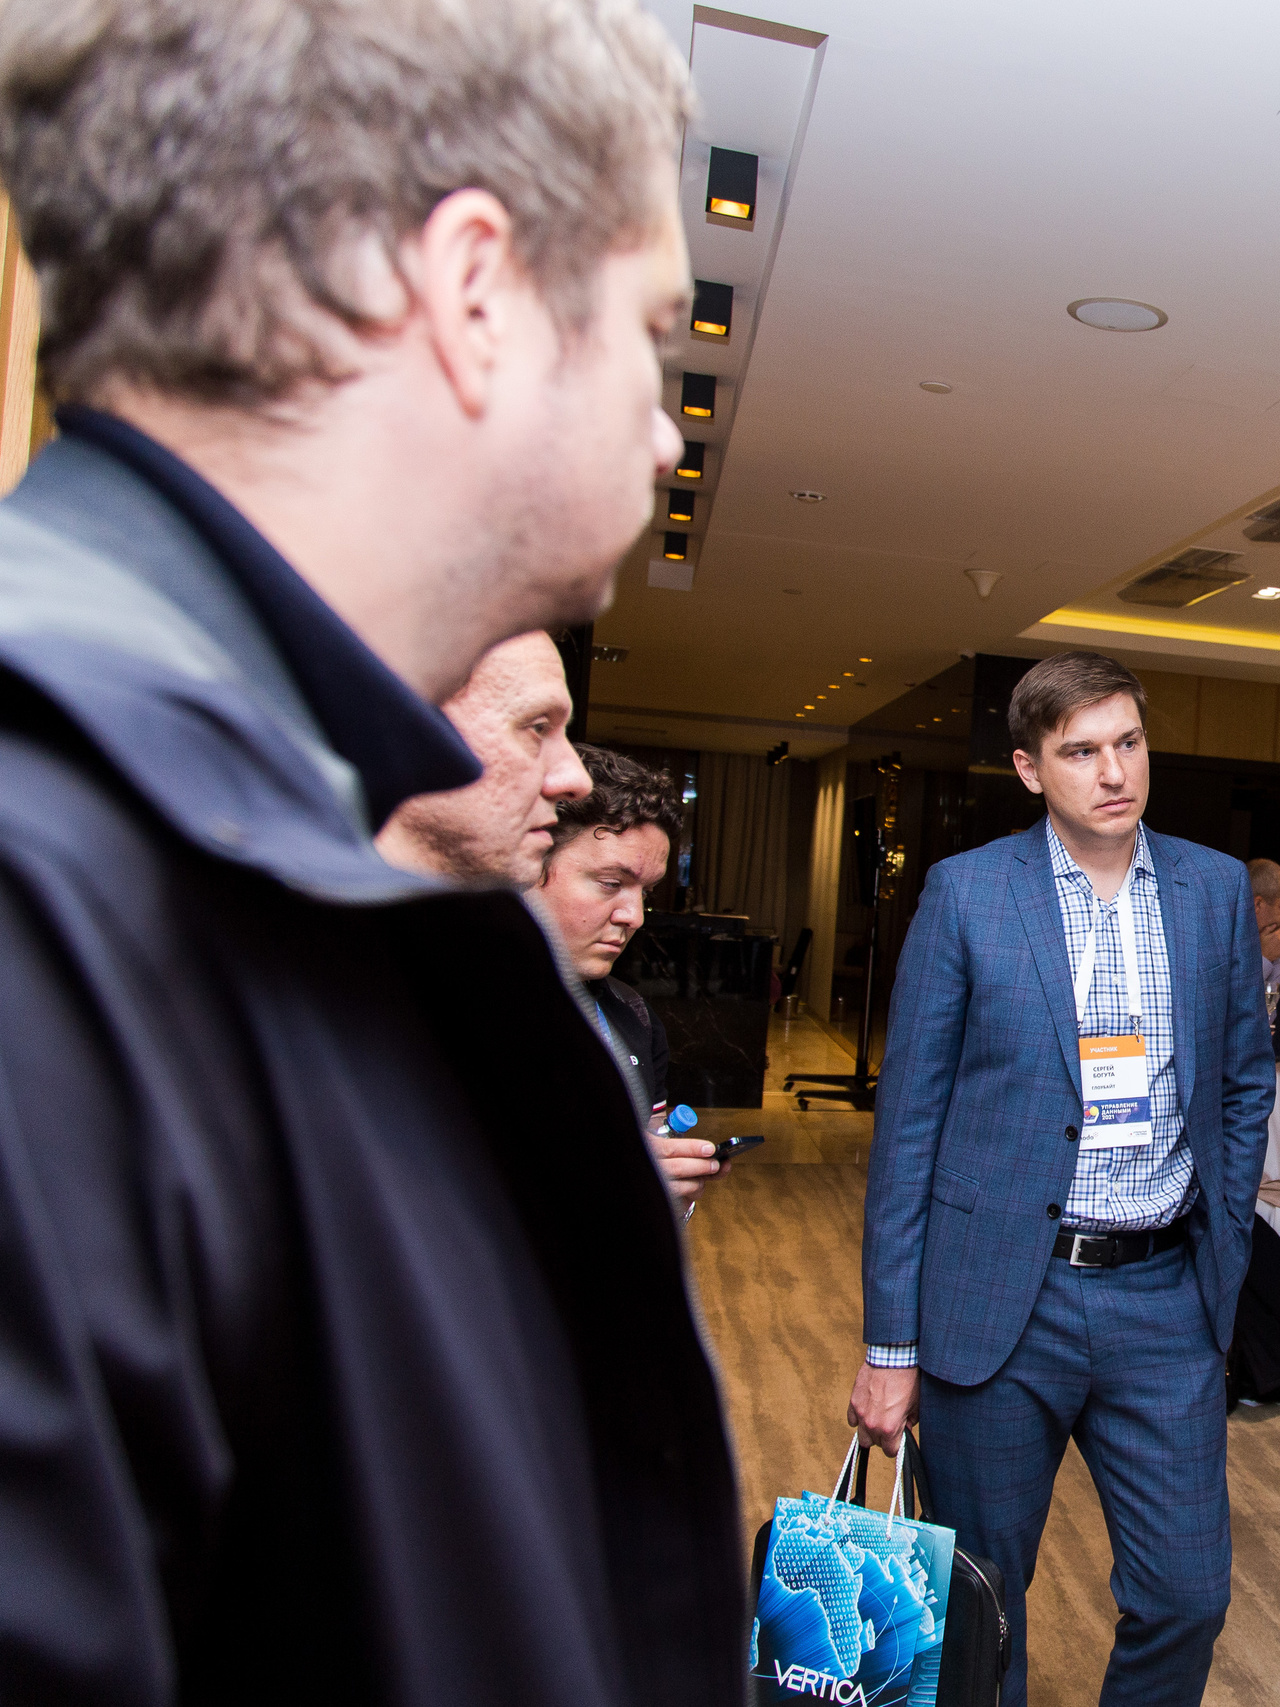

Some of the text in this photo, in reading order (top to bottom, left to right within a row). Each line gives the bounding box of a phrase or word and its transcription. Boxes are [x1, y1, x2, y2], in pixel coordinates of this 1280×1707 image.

[1089, 1046, 1118, 1054] УЧАСТНИК
[1092, 1064, 1115, 1072] СЕРГЕЙ
[1092, 1071, 1116, 1079] БОГУТА
[1101, 1102, 1138, 1110] УПРАВЛЕНИЕ
[1101, 1108, 1132, 1116] ДАННЫМИ
[774, 1658, 868, 1707] VERTICA
